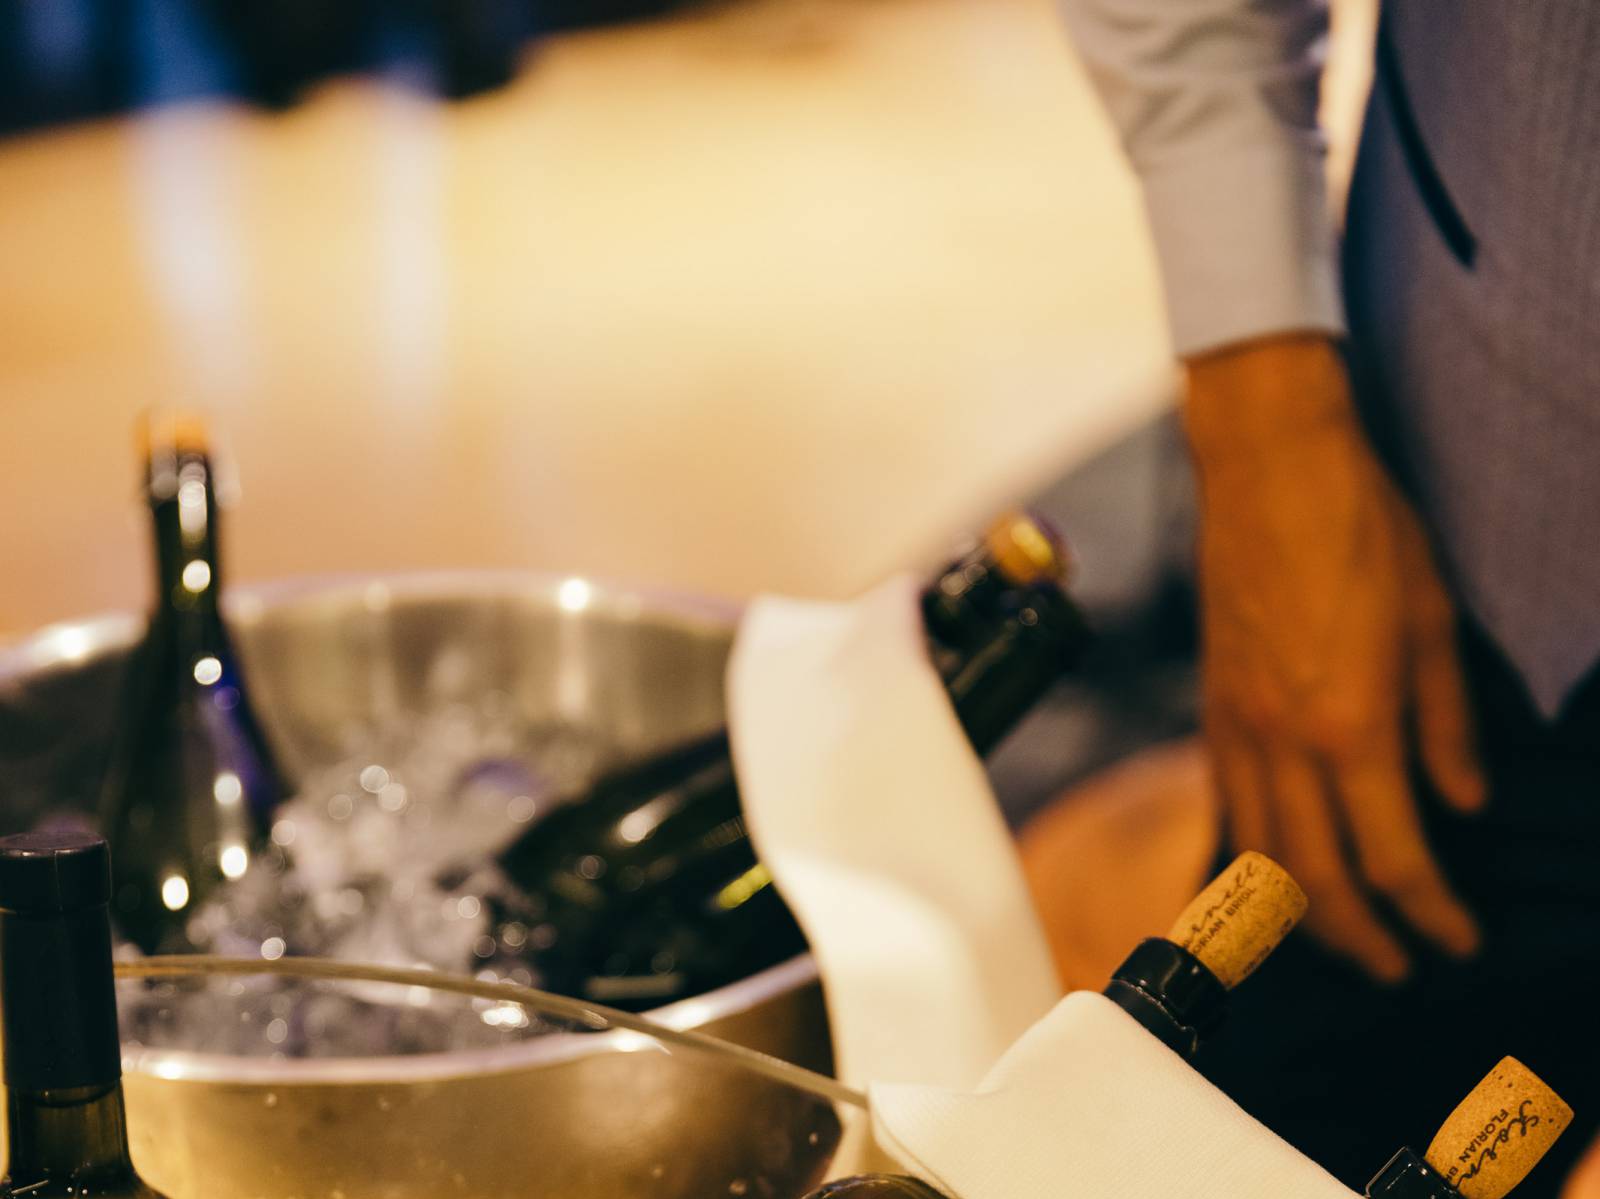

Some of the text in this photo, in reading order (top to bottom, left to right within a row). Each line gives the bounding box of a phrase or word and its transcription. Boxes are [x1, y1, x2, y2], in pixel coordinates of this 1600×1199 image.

[1193, 918, 1226, 954] ORIAN
[1452, 1100, 1540, 1191] Korn
[1458, 1108, 1510, 1164] FLORIAN
